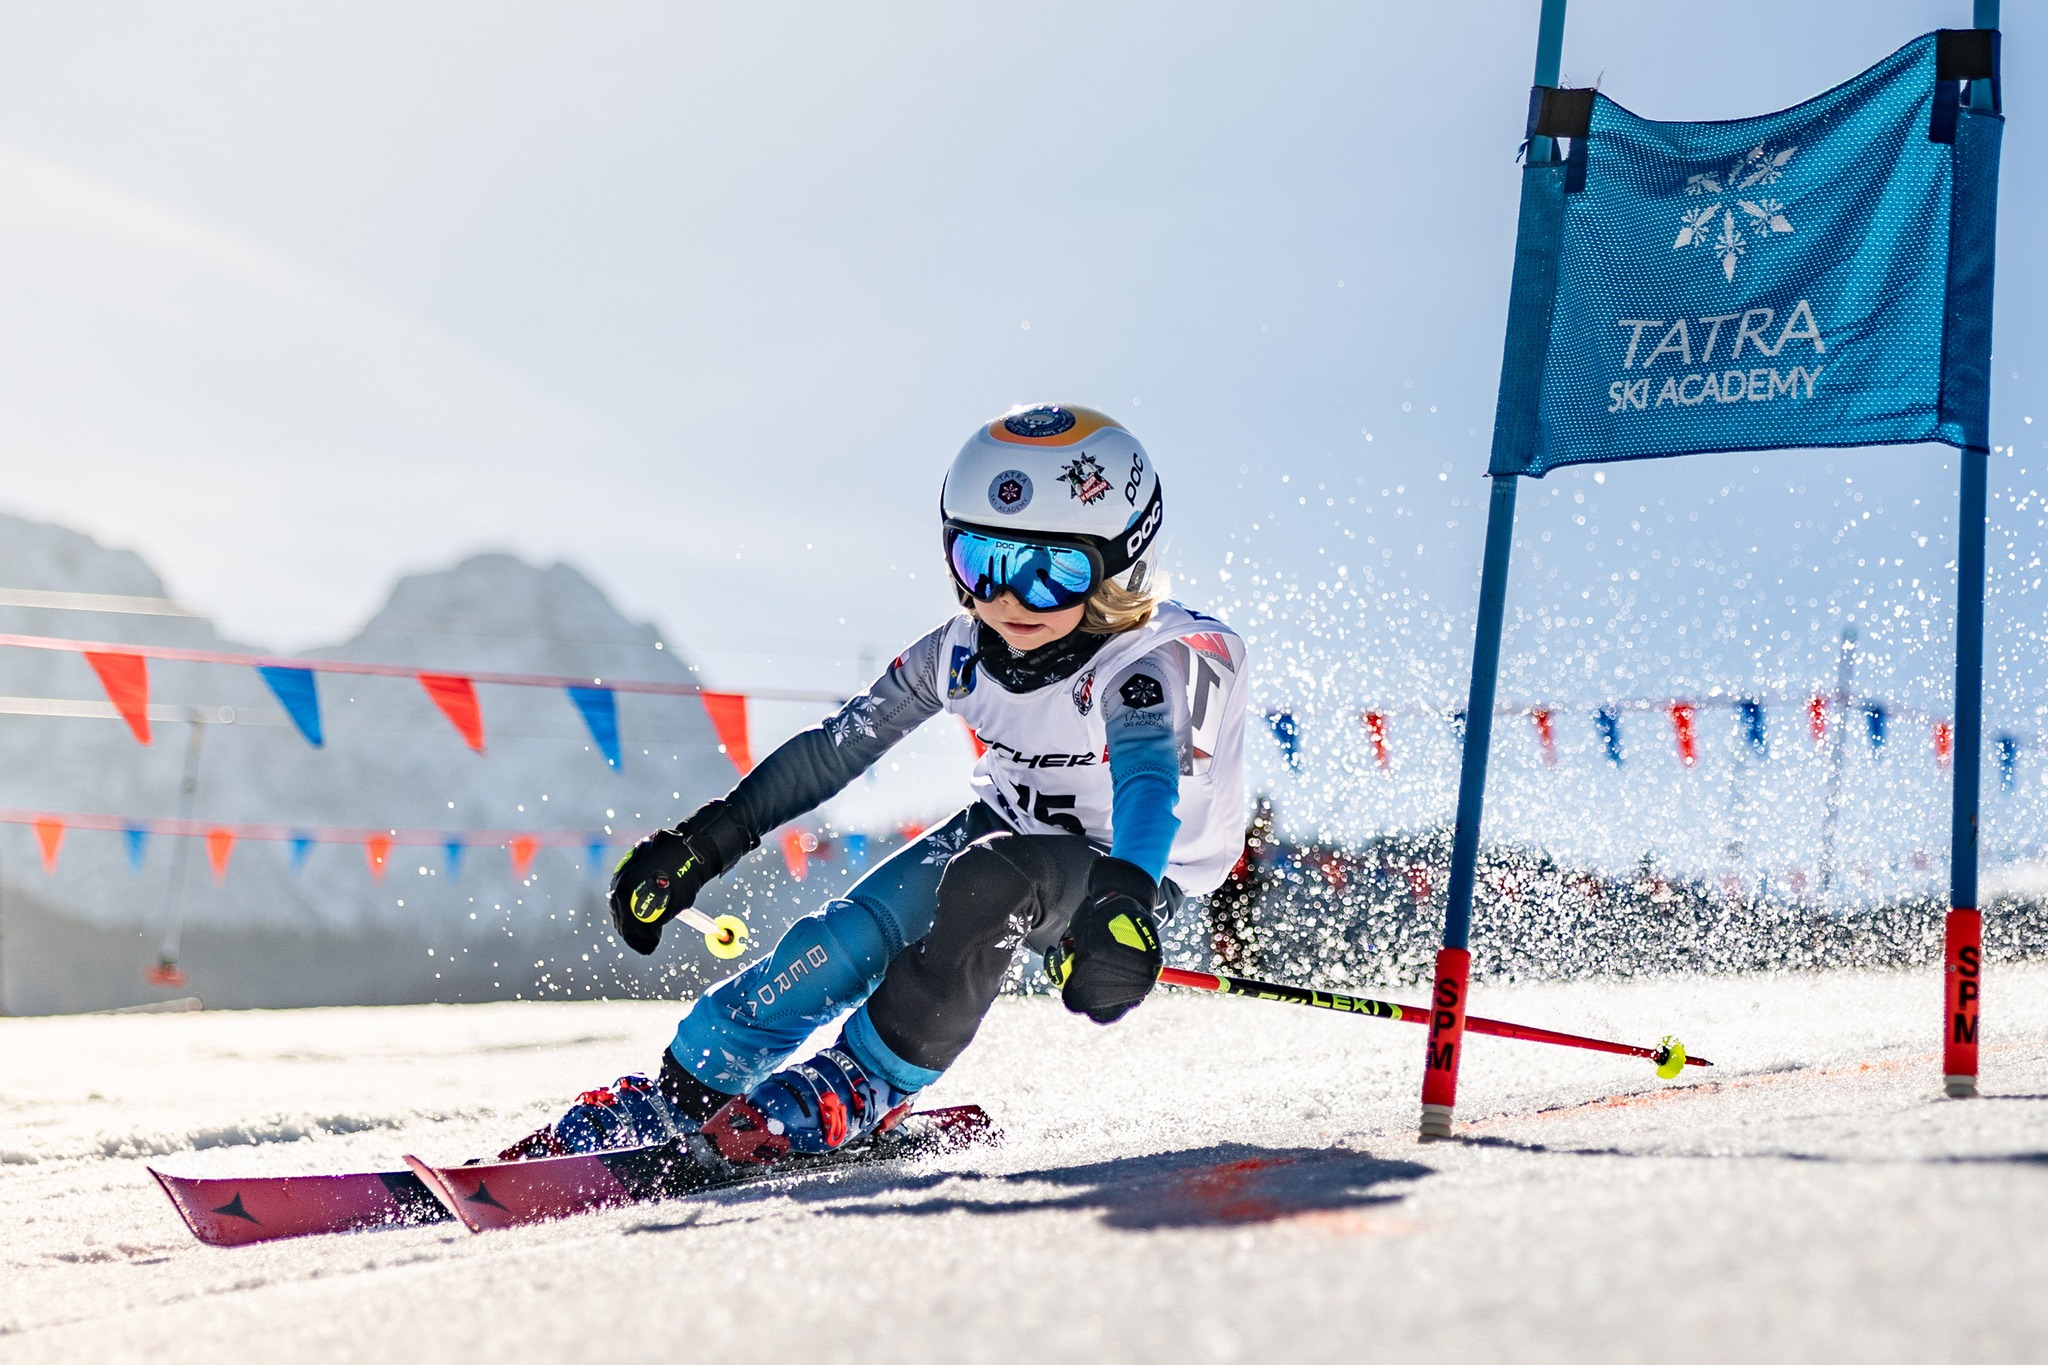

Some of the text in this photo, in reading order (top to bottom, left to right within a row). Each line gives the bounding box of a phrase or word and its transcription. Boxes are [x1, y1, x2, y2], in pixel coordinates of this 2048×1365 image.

[1618, 299, 1826, 369] TATRA
[1607, 364, 1825, 413] SKI ACADEMY
[998, 471, 1028, 485] TATRA
[990, 493, 1028, 513] SKI ACADEMY
[1135, 720, 1166, 730] ACADEMY
[977, 733, 1097, 769] CHER
[637, 892, 656, 917] LEKI
[1135, 917, 1157, 950] LEKI
[1311, 990, 1379, 1016] LEKI
[1953, 945, 1980, 1045] SPM
[1428, 977, 1459, 1072] SPM
